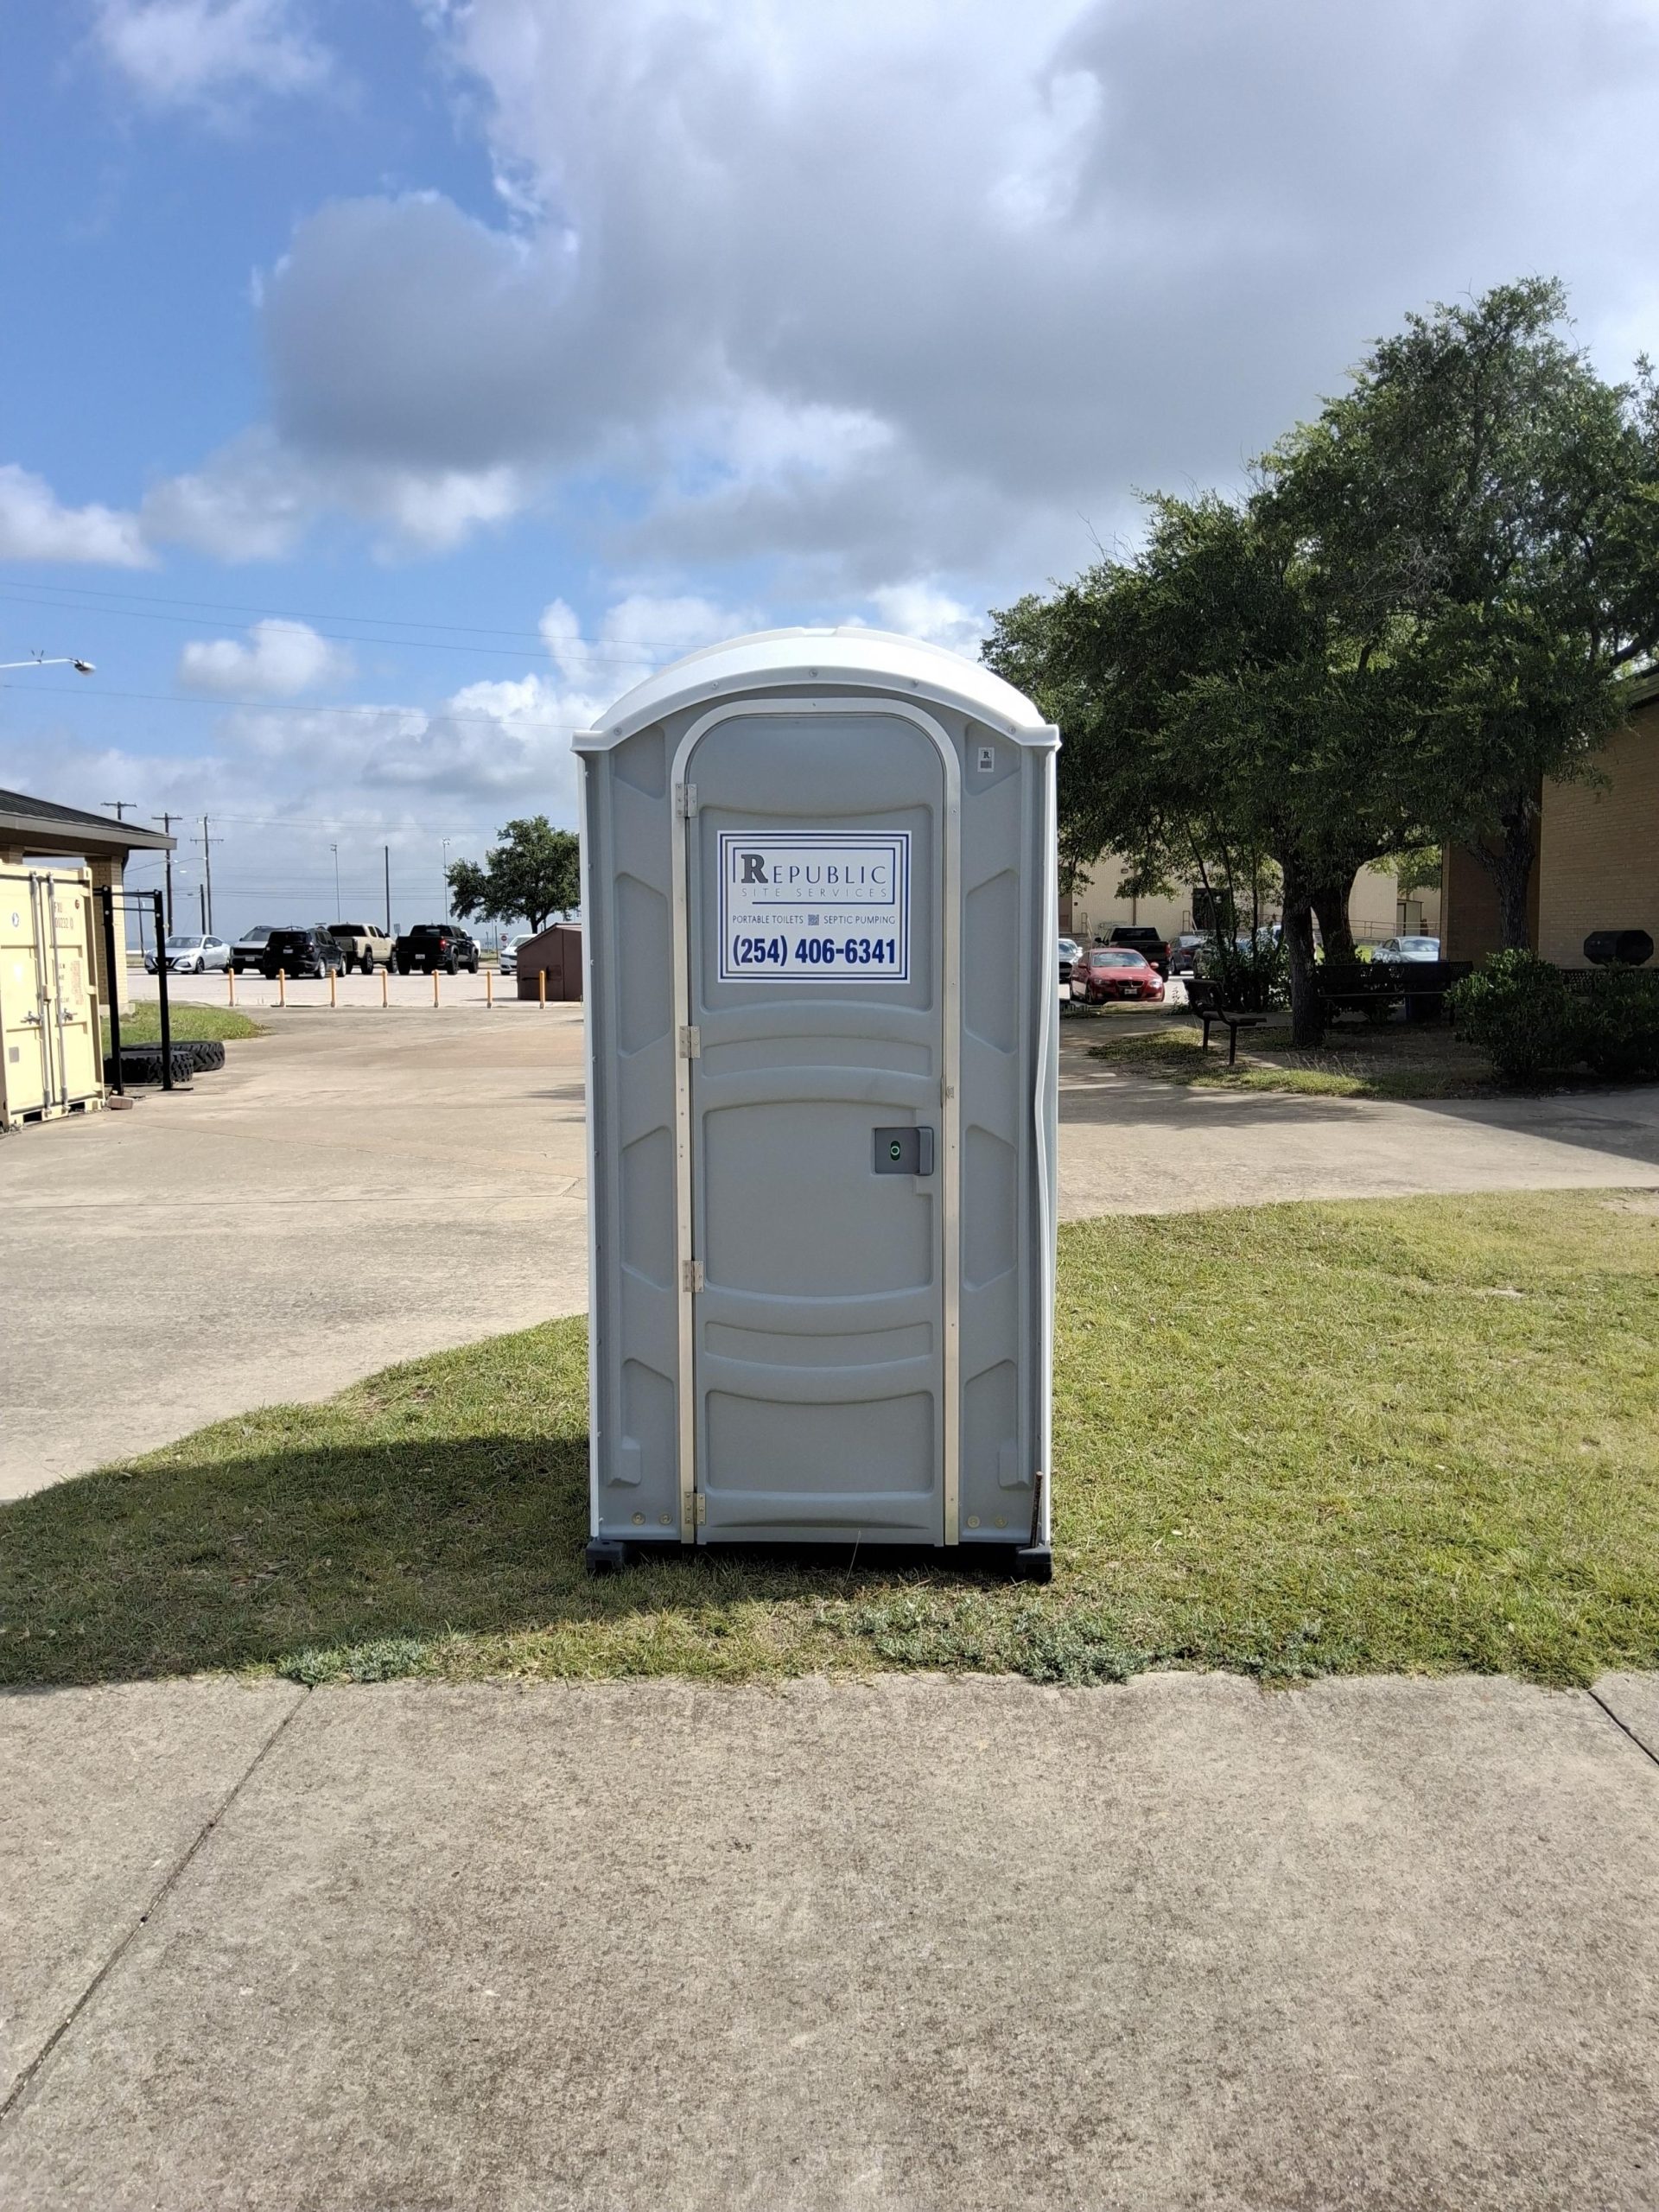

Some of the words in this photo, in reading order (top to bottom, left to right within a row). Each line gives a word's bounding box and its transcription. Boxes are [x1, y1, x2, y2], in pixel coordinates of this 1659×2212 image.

[741, 854, 887, 884] REPUBLIC
[741, 887, 781, 897] SITE
[796, 887, 887, 897] SERVICES
[733, 915, 770, 924] PORTABLE
[772, 915, 804, 925] TOILETS
[823, 915, 853, 925] SEPTIC
[855, 915, 895, 925] PUMPING
[733, 935, 788, 966] (254)
[795, 938, 895, 963] 406-6341
